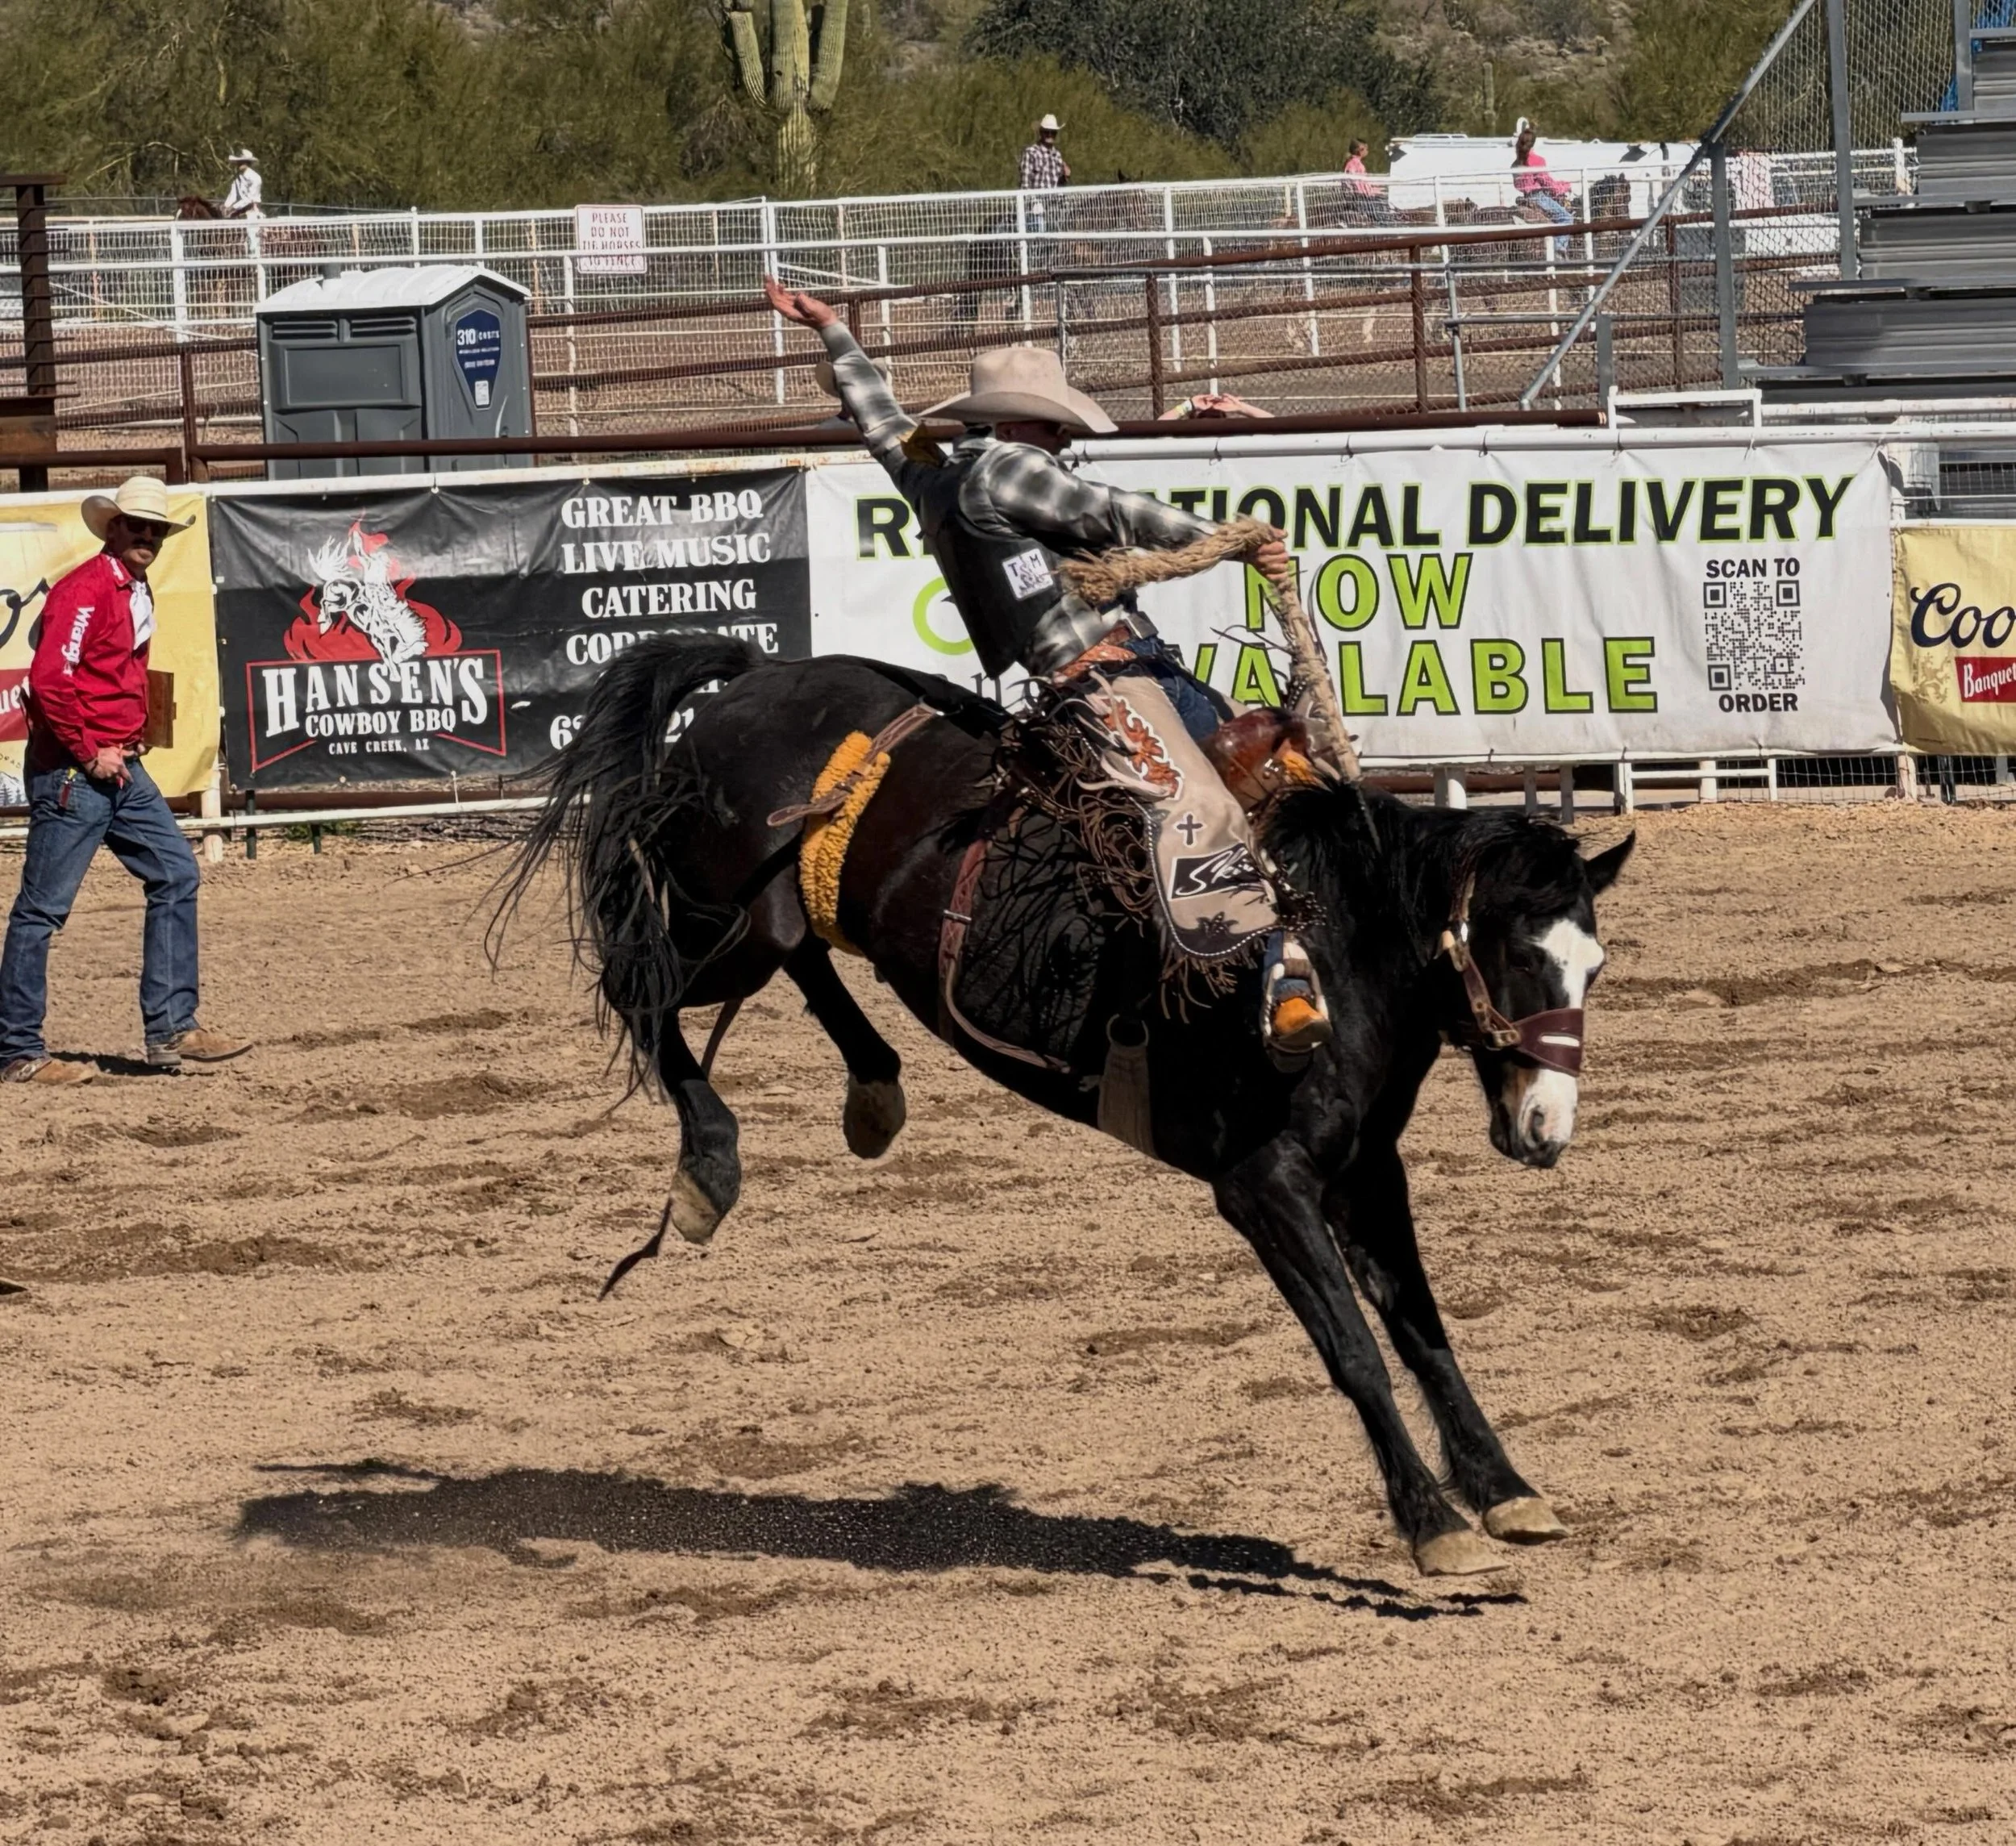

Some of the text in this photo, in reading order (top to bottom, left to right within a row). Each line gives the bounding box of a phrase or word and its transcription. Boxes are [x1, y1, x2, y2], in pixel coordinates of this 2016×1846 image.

[591, 227, 629, 237] DO NOT
[592, 213, 627, 223] PLEASE
[457, 328, 476, 345] 310
[562, 490, 764, 528] GREAT BBQ
[1467, 474, 1856, 548] DELIVERY
[561, 532, 771, 574] LIVE MUSIC
[1706, 557, 1800, 578] SCAN TO
[581, 579, 756, 619] CATERING
[1243, 552, 1473, 632] NOW
[261, 657, 488, 737] HANSEN'S
[1718, 693, 1798, 713] ORDER
[305, 707, 456, 737] COWBOY BBQ
[328, 741, 358, 755] CAVE
[415, 738, 430, 751] AZ
